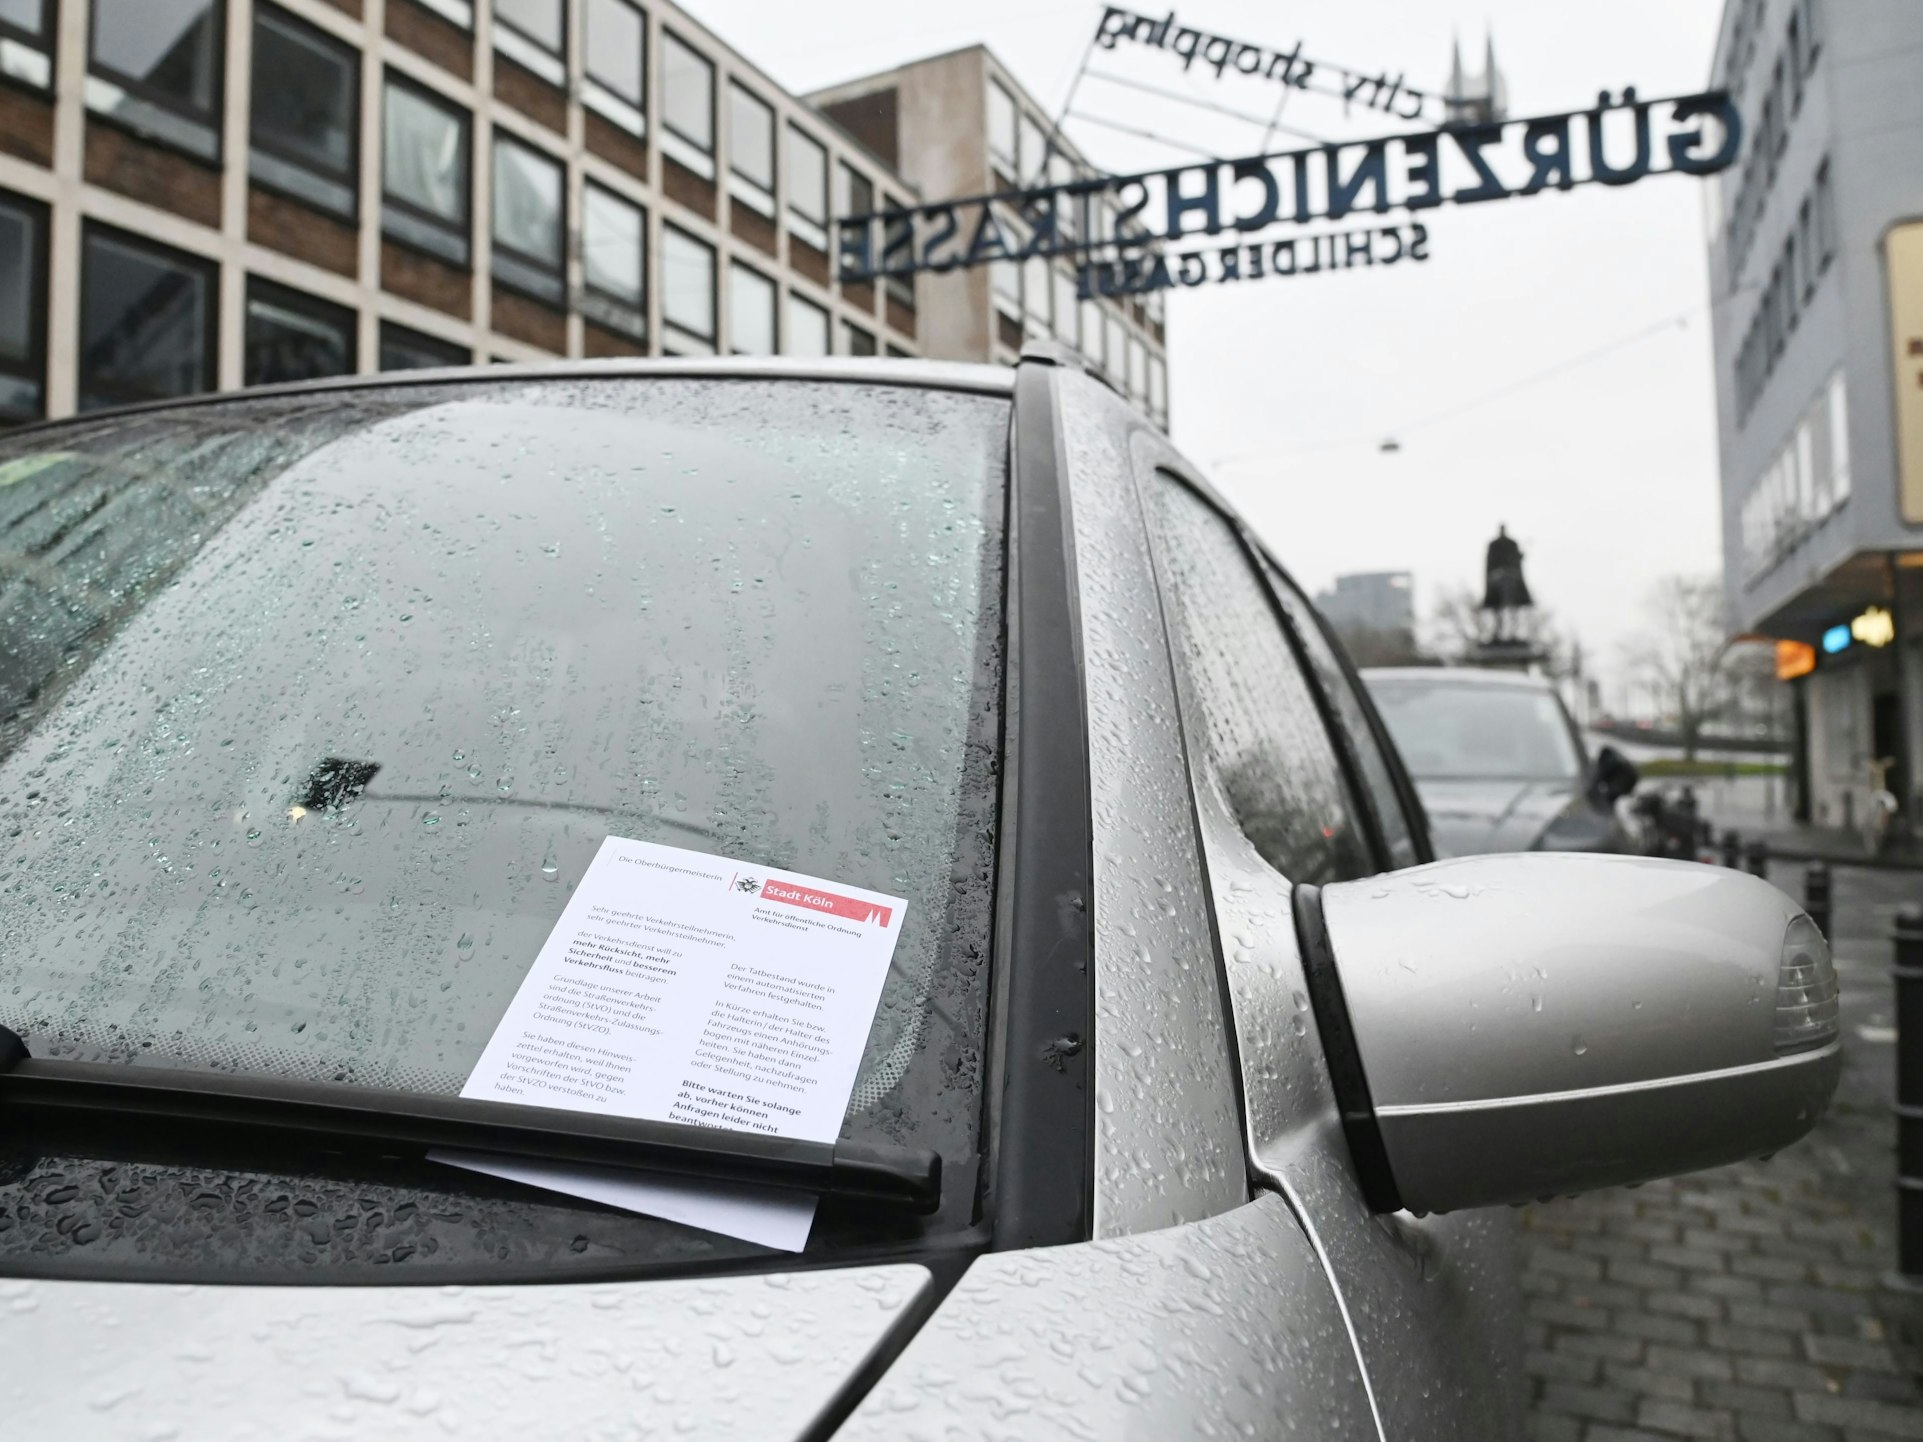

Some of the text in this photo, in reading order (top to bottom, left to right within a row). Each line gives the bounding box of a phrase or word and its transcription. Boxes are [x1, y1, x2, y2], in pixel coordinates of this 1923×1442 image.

[618, 854, 723, 882] Die Oberbürgermeisterin
[765, 884, 834, 909] Stadt Köln
[587, 913, 605, 922] sehr
[605, 917, 642, 929] geehrter
[592, 904, 610, 914] Sehr
[611, 909, 644, 921] geehrte
[752, 914, 809, 932] Verkehrsdienst
[754, 906, 862, 939] Amt für öffentliche Ordnung
[573, 939, 597, 949] mehr
[645, 954, 670, 964] mehr
[577, 929, 683, 958] der Verkehrsdienst will zu
[564, 955, 624, 975] Verkehrsfluss
[568, 946, 677, 976] Sicherheit und besserem
[548, 983, 568, 993] sind
[567, 987, 582, 996] die
[553, 973, 662, 1004] Grundlage unserer Arbeit
[724, 980, 766, 997] Verfahren
[726, 973, 825, 1002] einem automatisierten
[730, 962, 836, 994] Der Tatbestand wurde in
[533, 1011, 573, 1028] Ordnung
[543, 993, 647, 1021] ordnung (StVO) und die
[715, 999, 724, 1008] In
[725, 1001, 752, 1014] Kürze
[752, 1009, 790, 1024] erhalten
[791, 1017, 805, 1028] Sie
[707, 1018, 752, 1036] Fahrzeugs
[753, 1030, 779, 1042] einen
[711, 1009, 726, 1019] die
[727, 1012, 763, 1028] Halterin
[768, 1022, 784, 1032] der
[785, 1026, 813, 1040] Halter
[814, 1034, 830, 1045] des
[522, 1030, 536, 1040] Sie
[537, 1033, 566, 1047] haben
[566, 1040, 596, 1053] diesen
[703, 1027, 733, 1042] bogen
[733, 1036, 750, 1046] mit
[751, 1041, 789, 1056] näheren
[512, 1051, 569, 1070] vorgeworfen
[594, 1070, 625, 1083] gegen
[516, 1041, 544, 1053] zettel
[585, 1057, 605, 1067] weil
[605, 1060, 632, 1073] Ihnen
[690, 1059, 713, 1070] oder
[714, 1063, 752, 1082] Stellung
[752, 1075, 765, 1083] zu
[732, 1046, 747, 1056] Sie
[747, 1049, 777, 1064] haben
[778, 1057, 802, 1070] dann
[500, 1071, 608, 1103] der StVZO verstoßen zu
[507, 1060, 562, 1080] Vorschriften
[562, 1073, 579, 1084] der
[580, 1077, 605, 1090] StVO
[755, 1064, 818, 1086] nachzufragen
[682, 1079, 802, 1116] Bitte warten Sie solange
[695, 1095, 729, 1109] vorher
[730, 1102, 768, 1119] können
[672, 1100, 778, 1134] Anfragen leider nicht
